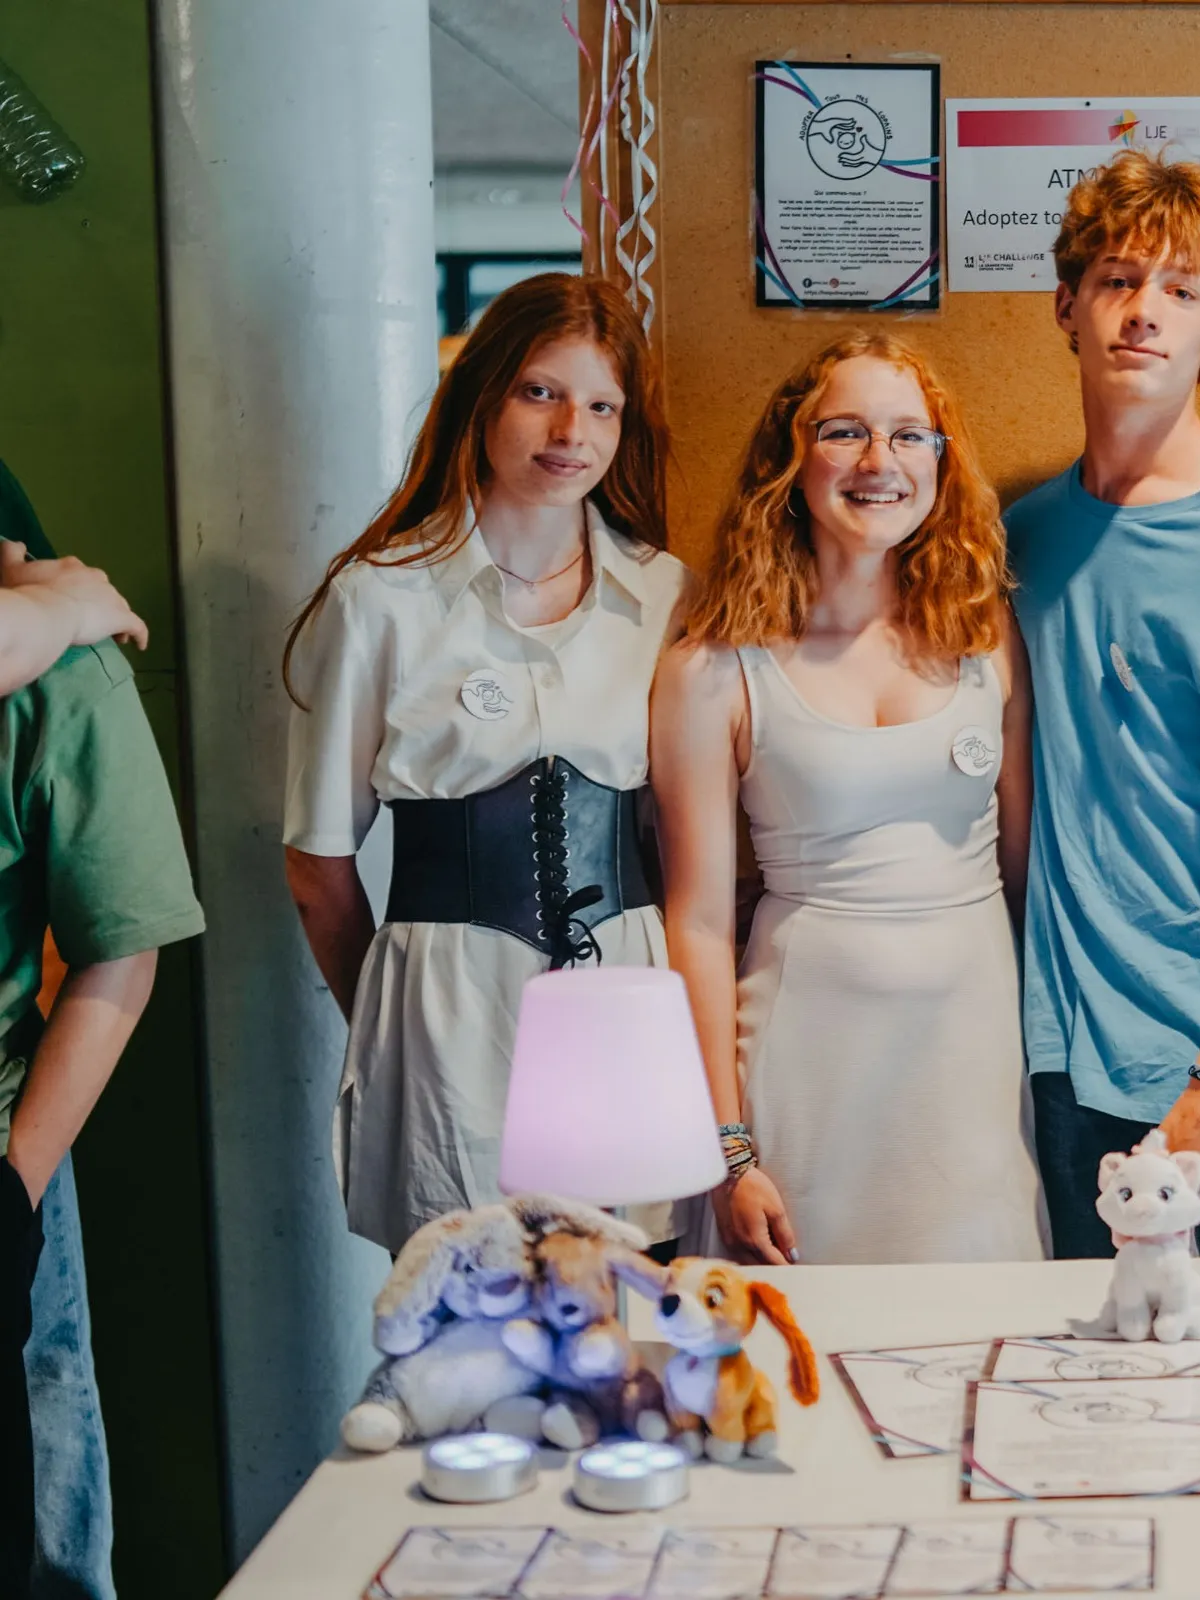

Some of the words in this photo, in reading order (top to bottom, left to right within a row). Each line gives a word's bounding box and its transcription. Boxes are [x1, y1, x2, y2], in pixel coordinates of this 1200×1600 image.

[1145, 125, 1168, 139] LJE
[963, 209, 1038, 229] Adoptez
[964, 256, 974, 264] 11
